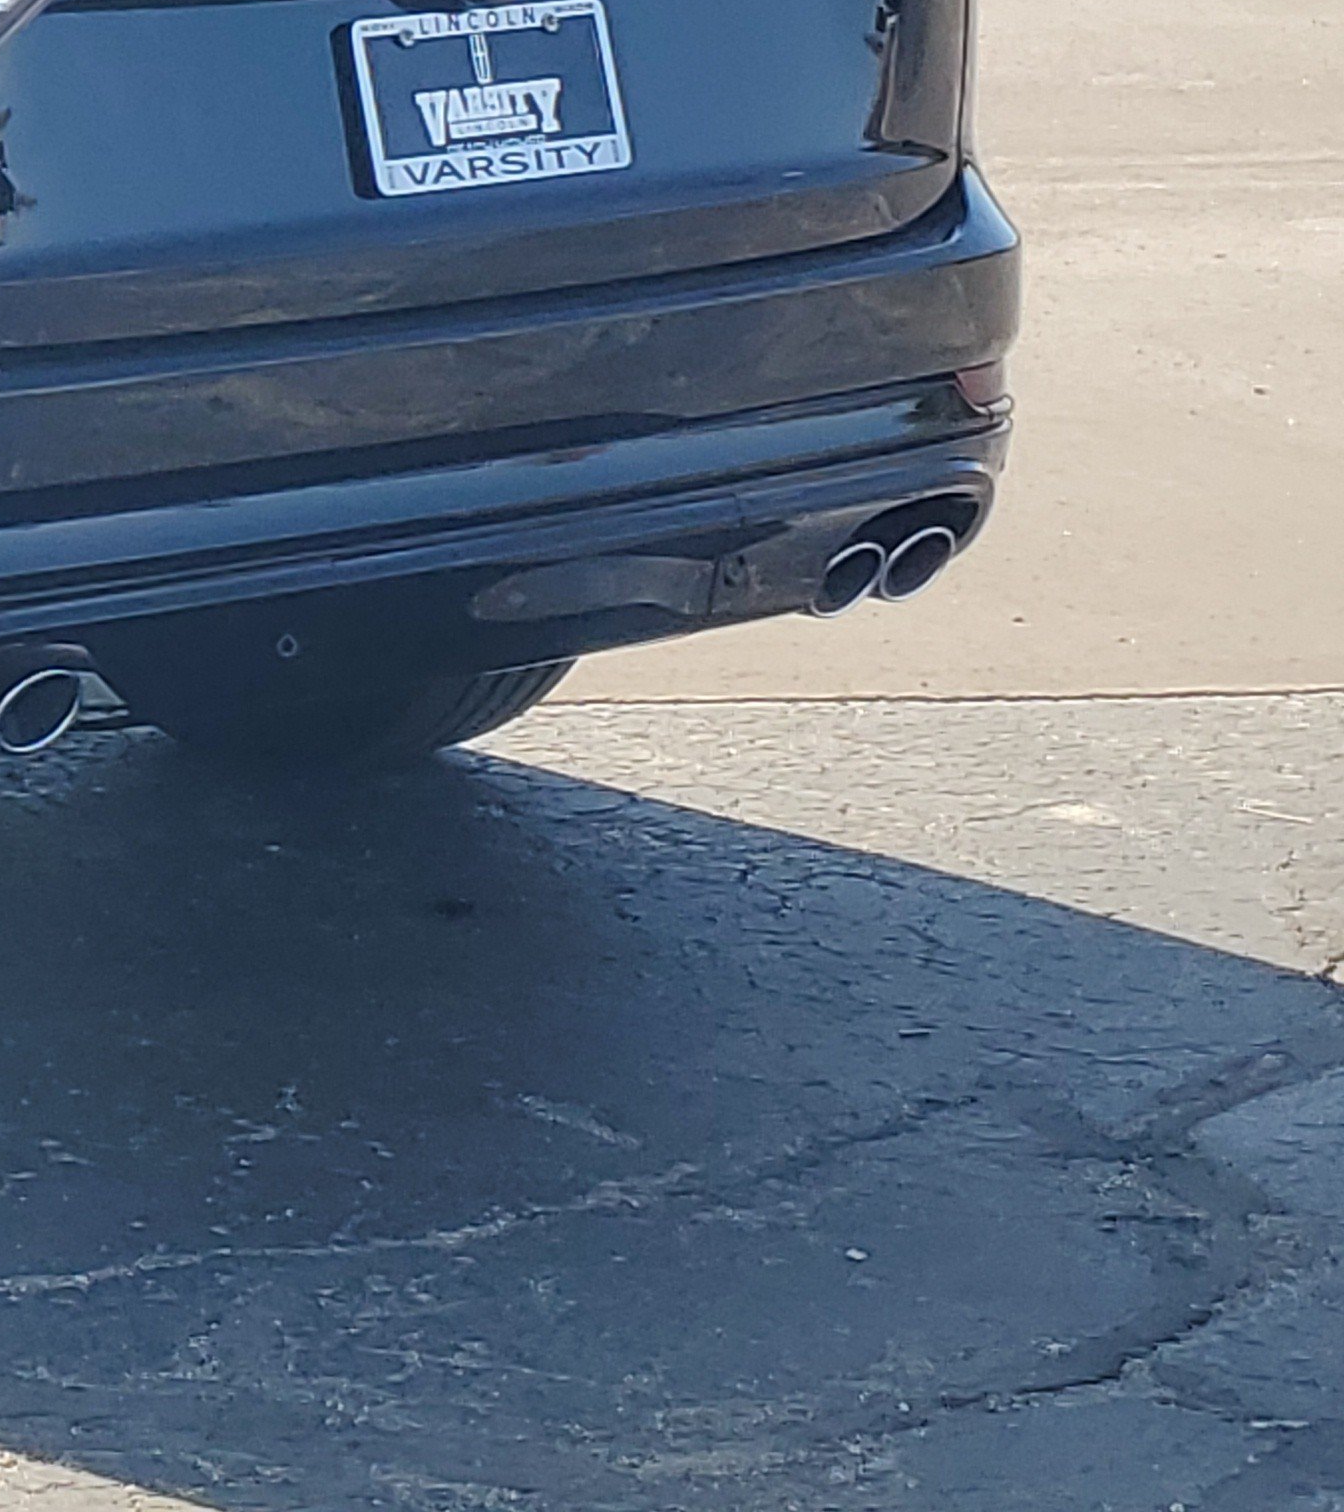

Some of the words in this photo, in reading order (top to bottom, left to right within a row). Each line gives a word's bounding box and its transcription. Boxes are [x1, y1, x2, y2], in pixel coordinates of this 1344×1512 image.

[418, 6, 537, 36] LINCOLN
[414, 78, 561, 147] VARSITY
[403, 141, 602, 186] VARSITY
